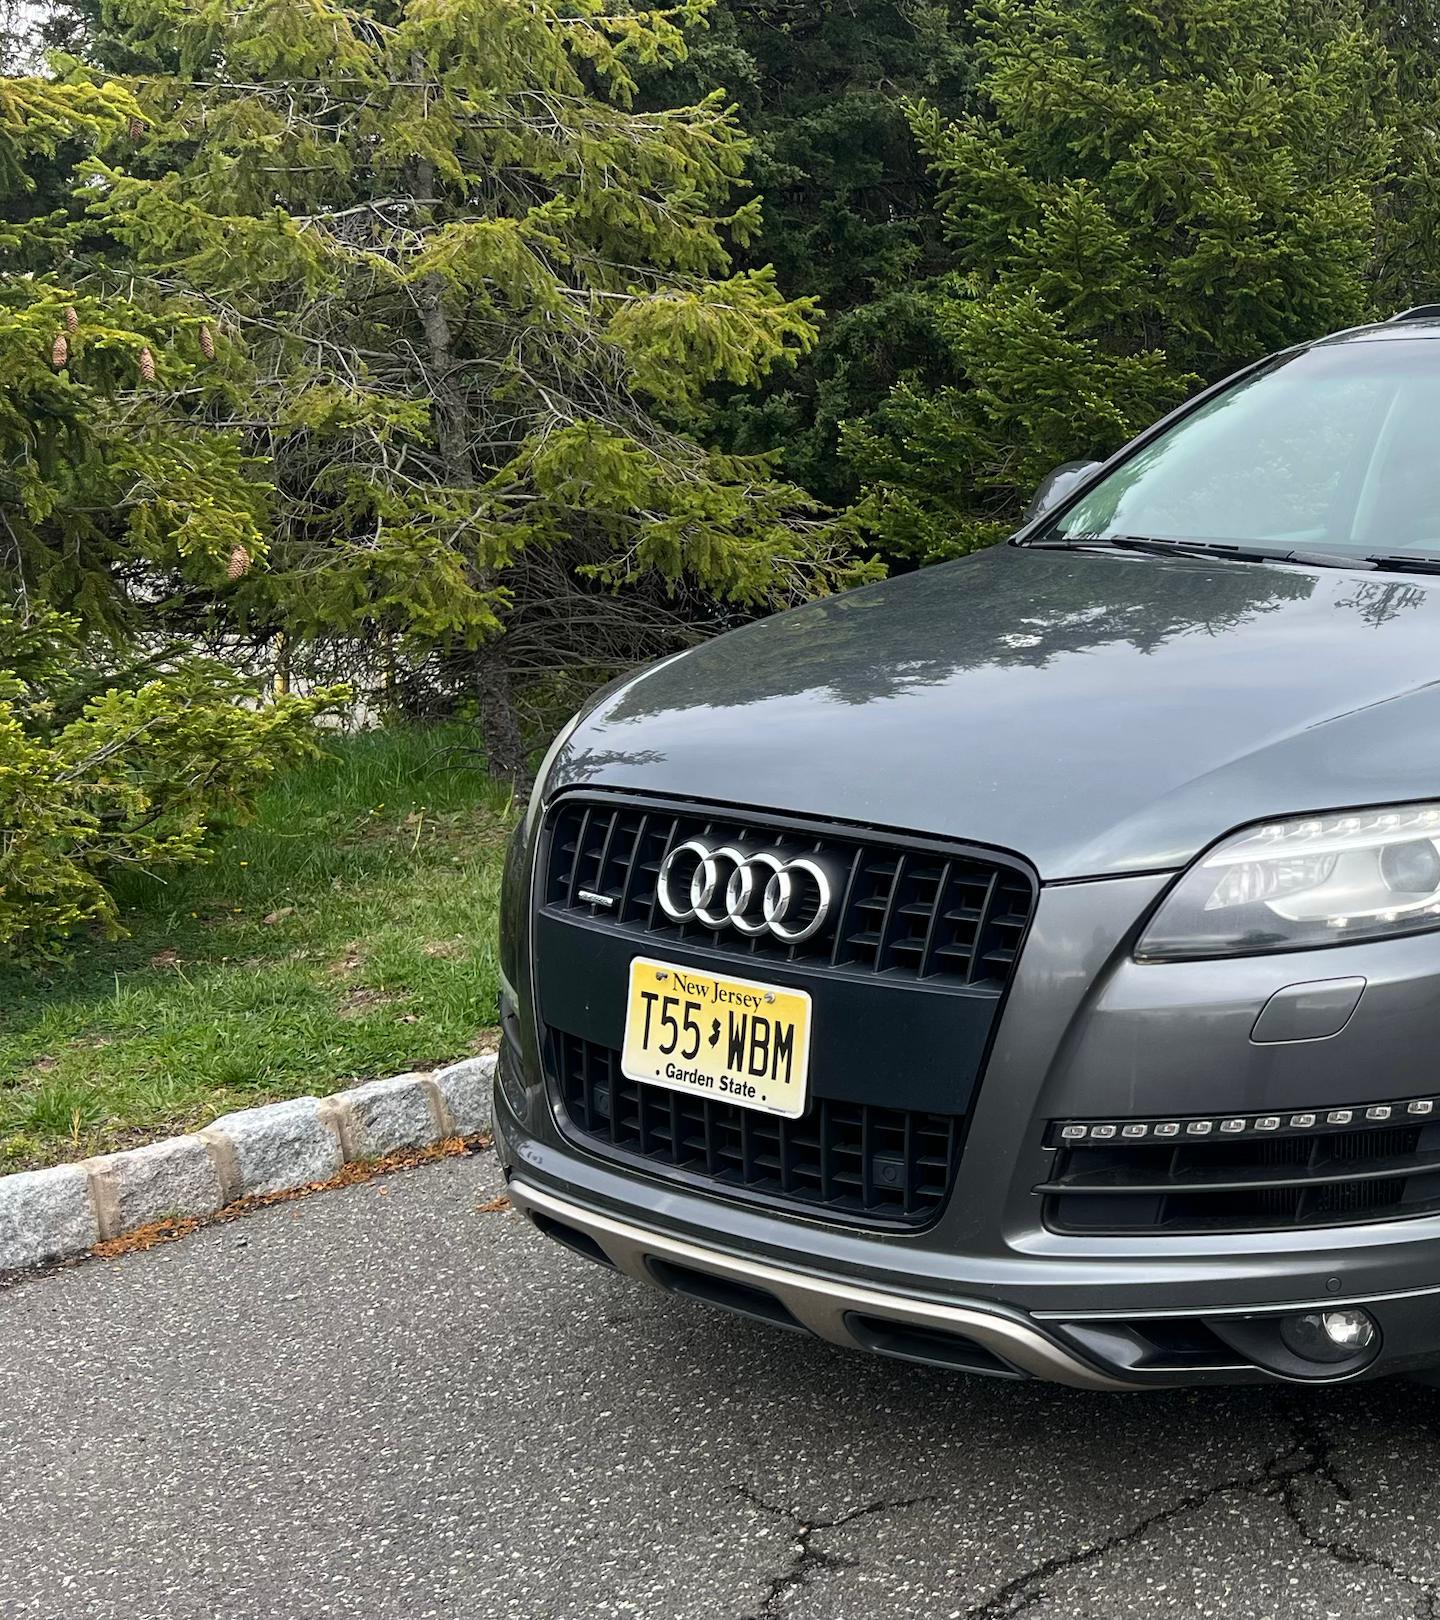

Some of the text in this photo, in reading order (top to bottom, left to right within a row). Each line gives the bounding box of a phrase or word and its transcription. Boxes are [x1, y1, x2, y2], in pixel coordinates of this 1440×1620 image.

[673, 973, 763, 1012] New Jersey
[641, 991, 795, 1084] T55 WBM
[665, 1062, 757, 1098] Garden State
